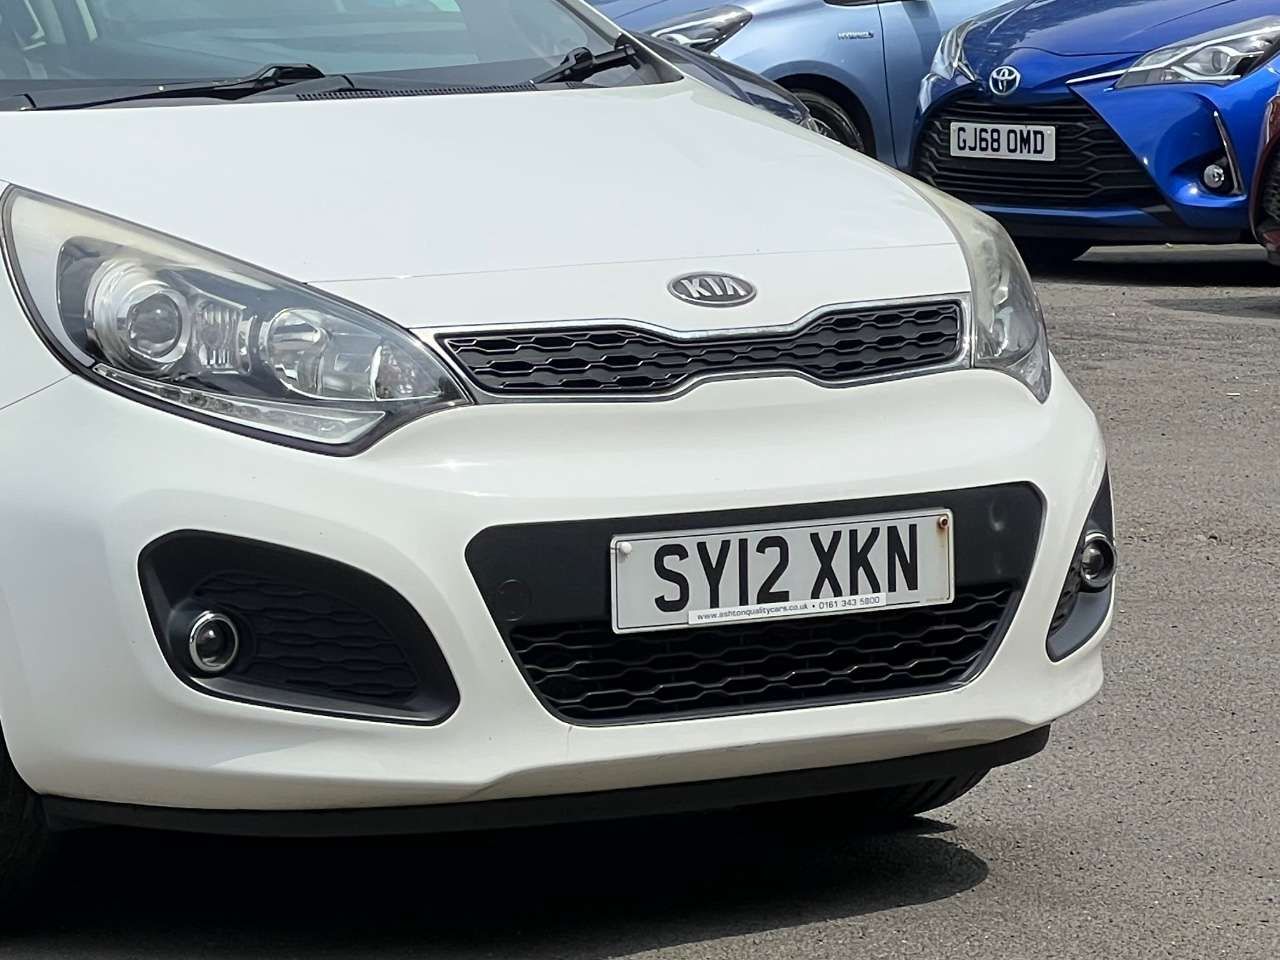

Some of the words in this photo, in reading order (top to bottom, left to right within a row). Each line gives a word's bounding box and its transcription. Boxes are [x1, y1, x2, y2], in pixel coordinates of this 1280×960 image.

[957, 126, 1001, 153] GJ68
[1007, 129, 1045, 155] OMD
[680, 276, 747, 299] KIA
[653, 535, 790, 613] SY12
[809, 523, 919, 600] XKN
[818, 600, 838, 610] 0161
[841, 597, 857, 608] 343
